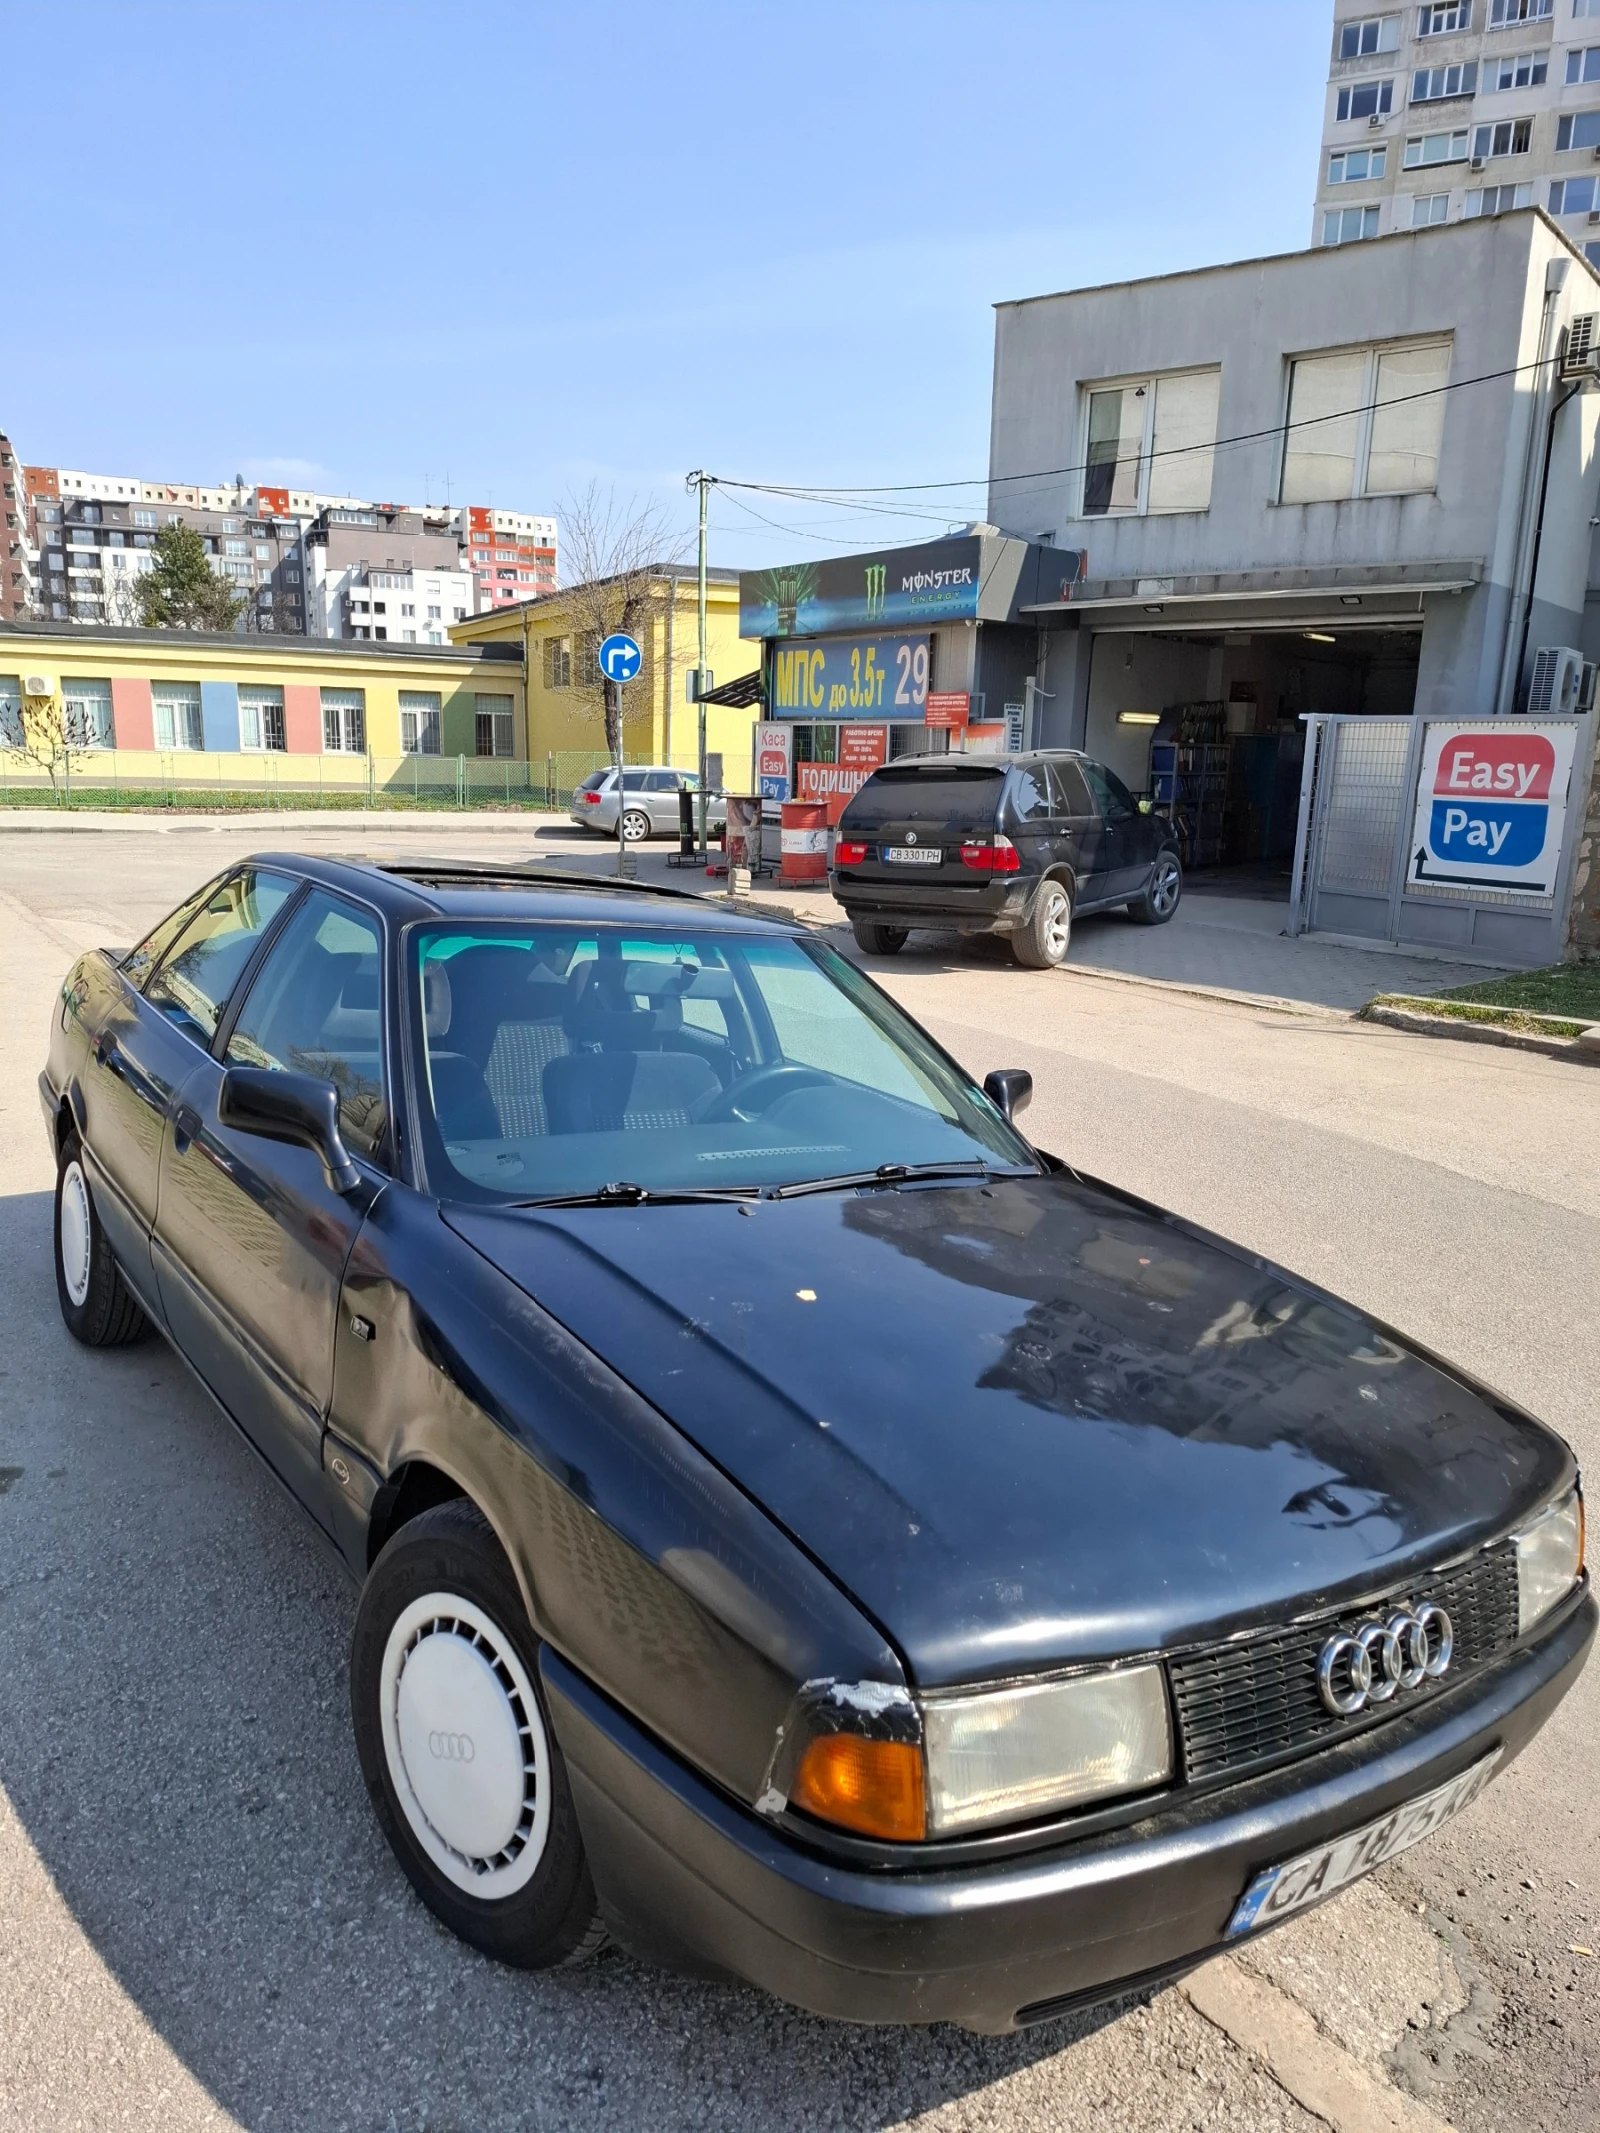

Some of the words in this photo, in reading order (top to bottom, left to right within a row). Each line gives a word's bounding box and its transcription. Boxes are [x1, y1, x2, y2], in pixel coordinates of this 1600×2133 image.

[911, 590, 961, 604] ENERGY
[776, 649, 825, 707] МПС
[829, 684, 846, 712] до
[894, 644, 929, 705] 29
[761, 730, 786, 746] Каса
[763, 757, 784, 775] Easy
[1448, 751, 1541, 798] Easy
[763, 779, 779, 797] Pay
[1443, 808, 1512, 856] Pay
[890, 849, 902, 860] CB
[903, 849, 925, 861] 3301
[926, 850, 940, 862] PH
[1265, 1850, 1334, 1914] CA
[1233, 1906, 1258, 1926] BG
